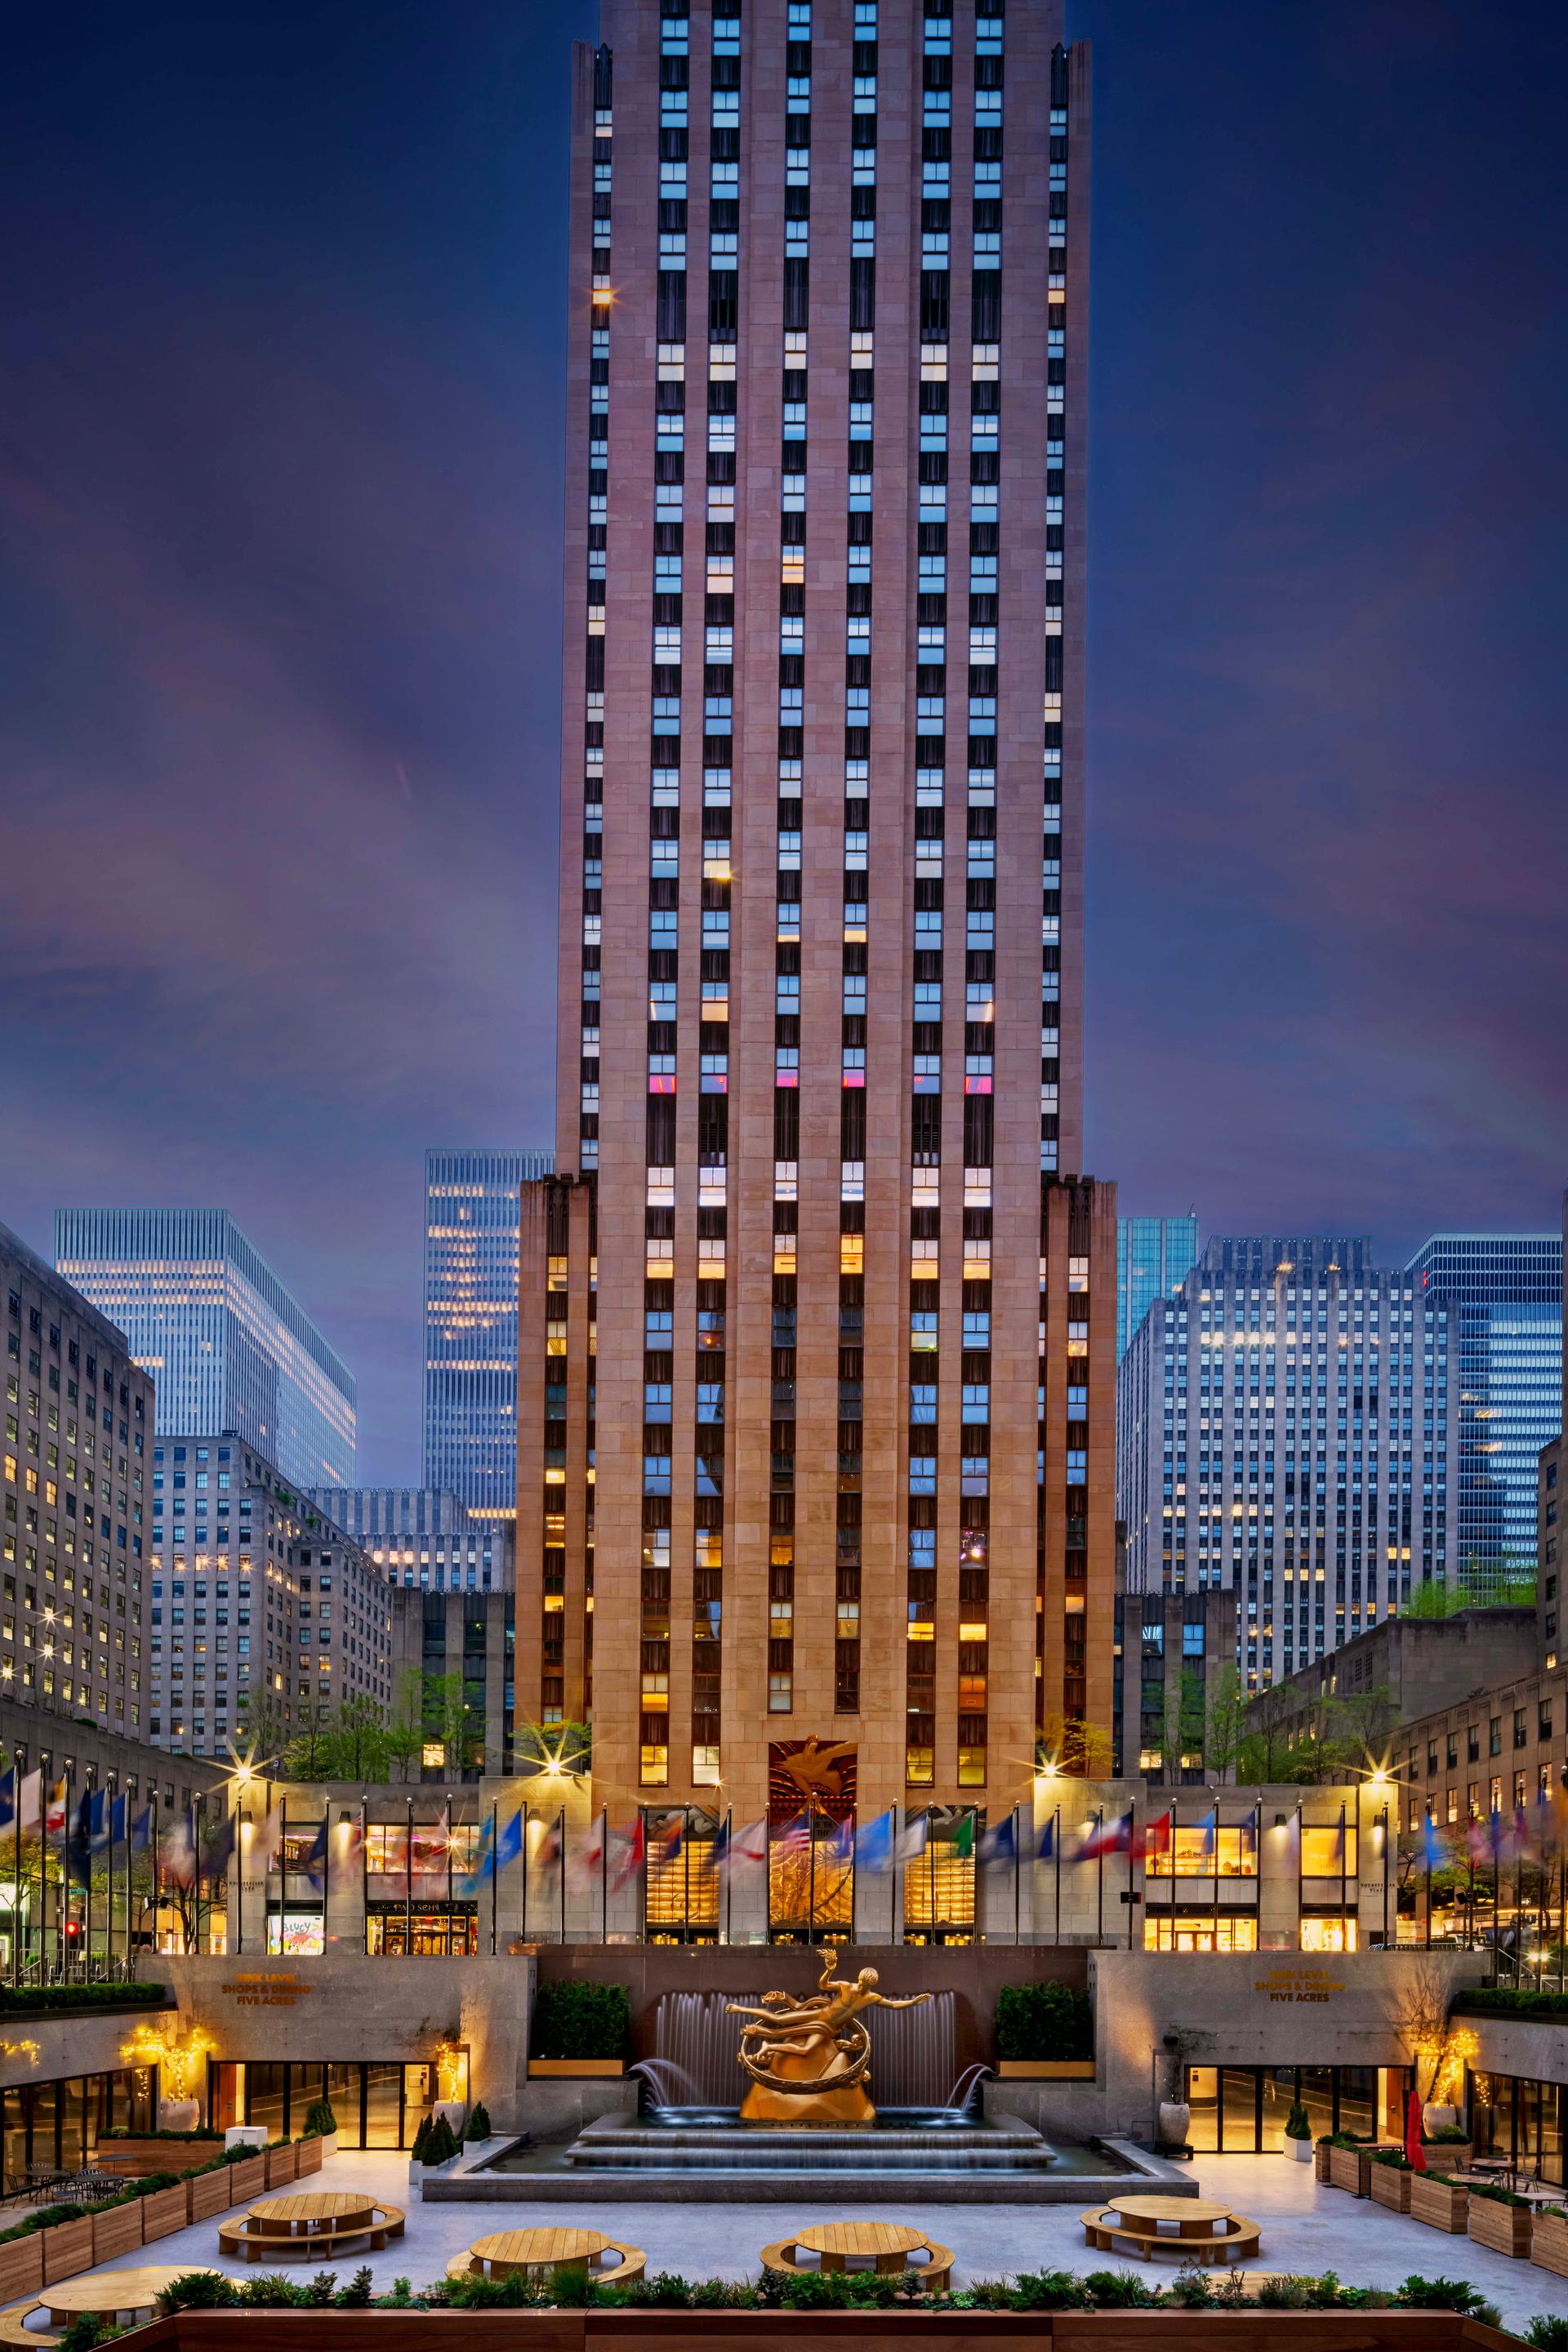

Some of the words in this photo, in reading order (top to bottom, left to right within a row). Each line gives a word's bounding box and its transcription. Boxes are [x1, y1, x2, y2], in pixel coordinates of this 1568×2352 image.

[221, 1984, 258, 1994] SHOPS
[261, 1985, 269, 1994] &
[271, 1984, 312, 1994] DINING
[1254, 1982, 1292, 1992] SHOPS
[236, 1996, 259, 2006] FIVE
[261, 1996, 297, 2006] ACRES
[1270, 1993, 1294, 2002] FIVE
[1295, 1993, 1330, 2002] ACRES
